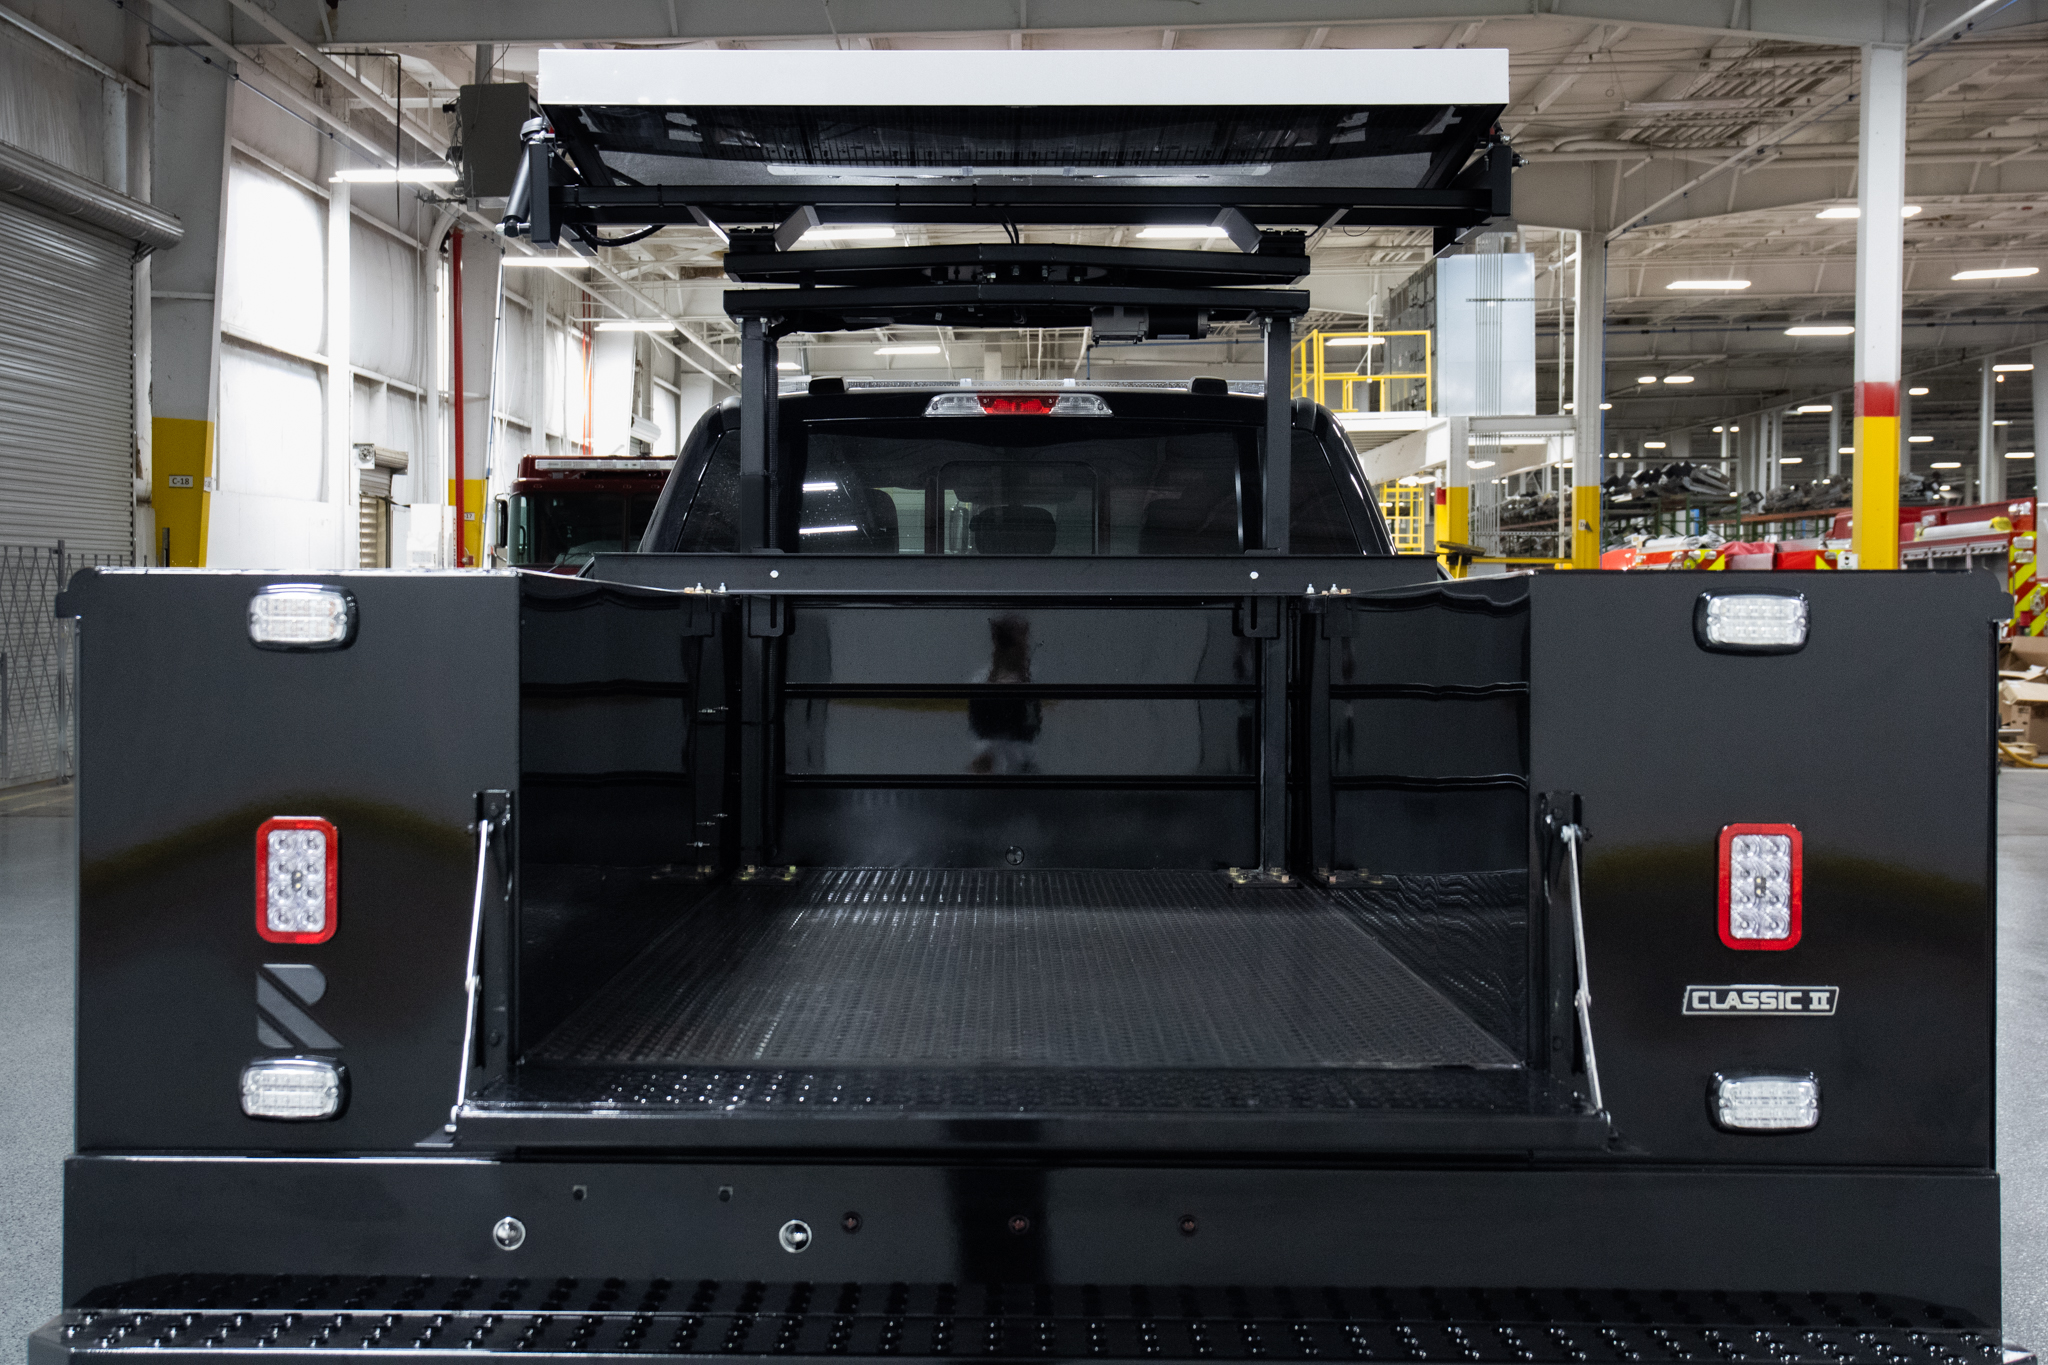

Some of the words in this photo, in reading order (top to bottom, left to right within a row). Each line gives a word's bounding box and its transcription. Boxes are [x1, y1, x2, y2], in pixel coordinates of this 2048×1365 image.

[172, 477, 190, 485] C-18
[1691, 991, 1803, 1010] CLASSIC
[1809, 991, 1830, 1010] II
